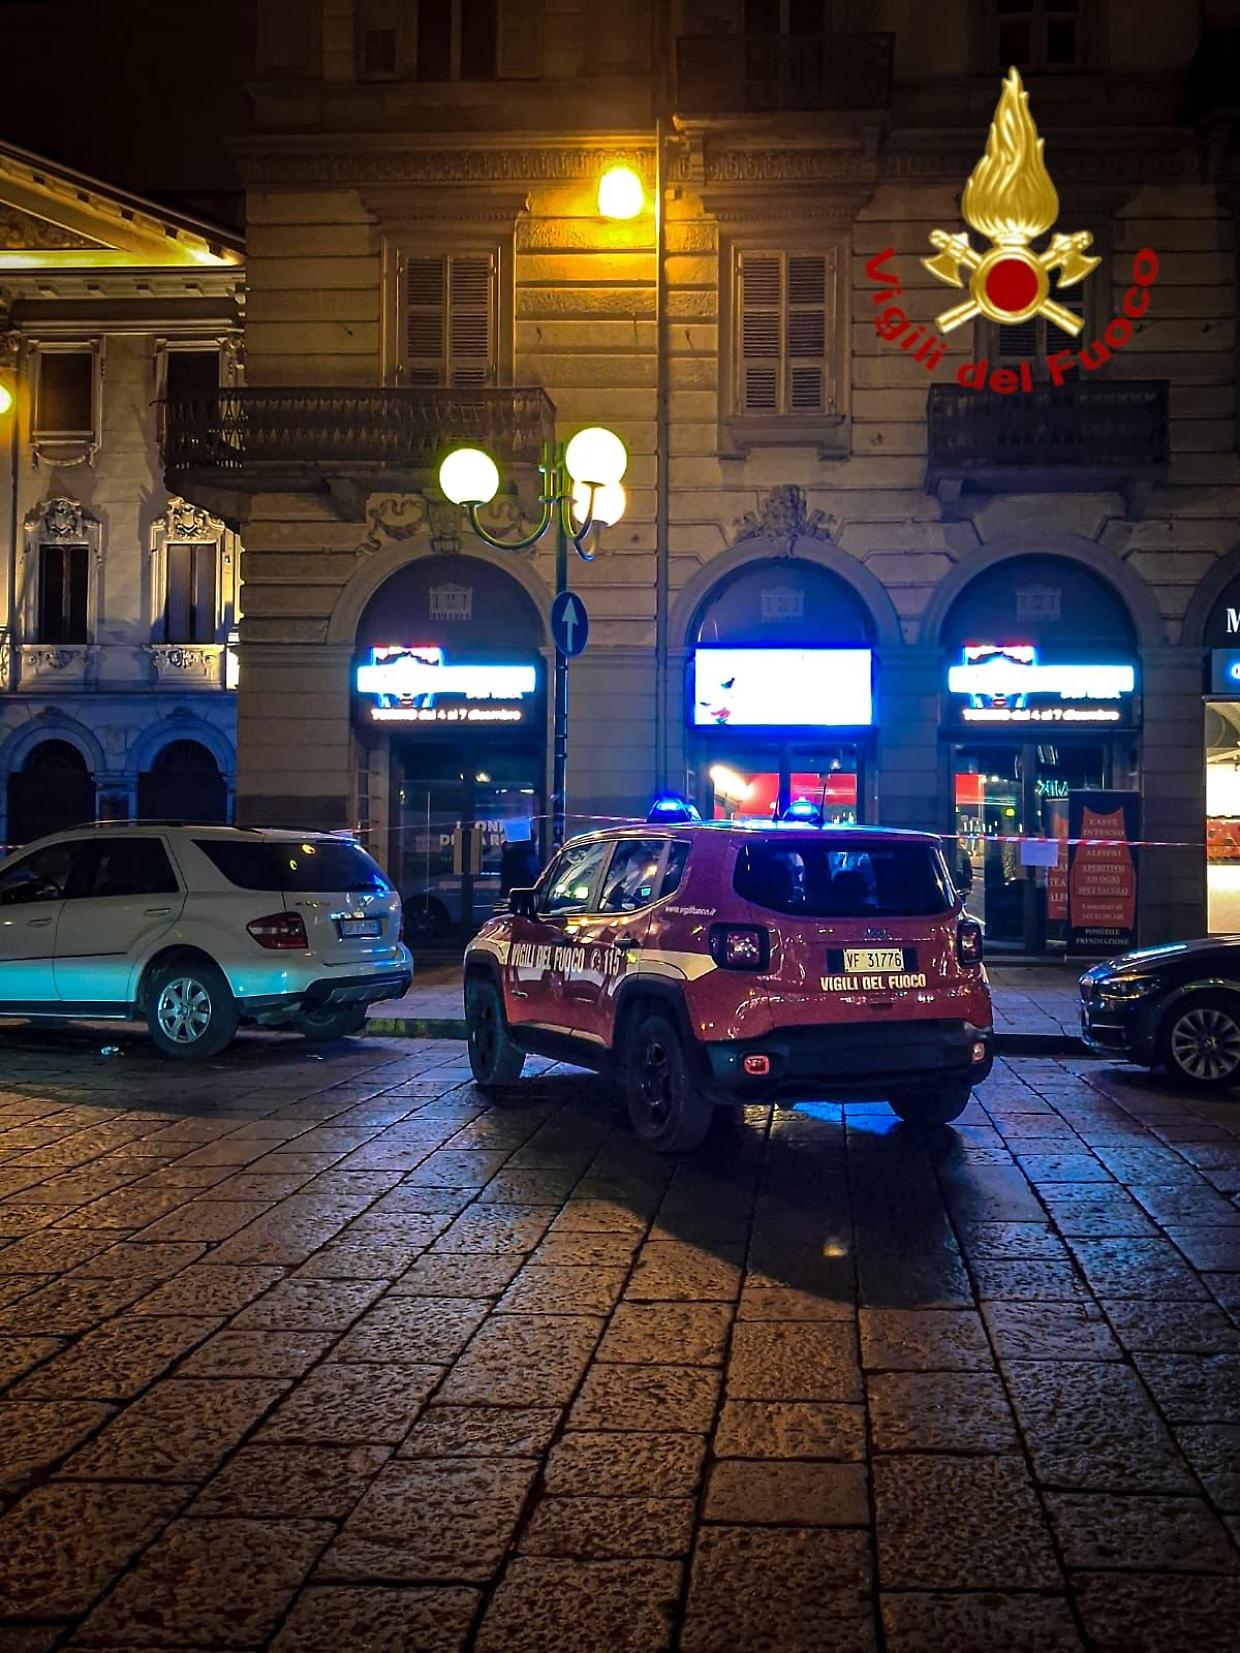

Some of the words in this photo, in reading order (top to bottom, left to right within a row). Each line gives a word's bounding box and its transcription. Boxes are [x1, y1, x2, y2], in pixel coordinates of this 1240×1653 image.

[511, 943, 536, 968] VIGILI
[536, 945, 552, 970] DEL
[554, 946, 585, 973] FUOCO
[604, 948, 620, 976] 115
[846, 953, 860, 964] VF
[867, 953, 901, 967] 31776
[820, 976, 859, 991] VIGILI
[862, 975, 886, 990] DEL
[888, 973, 926, 988] FUOCO
